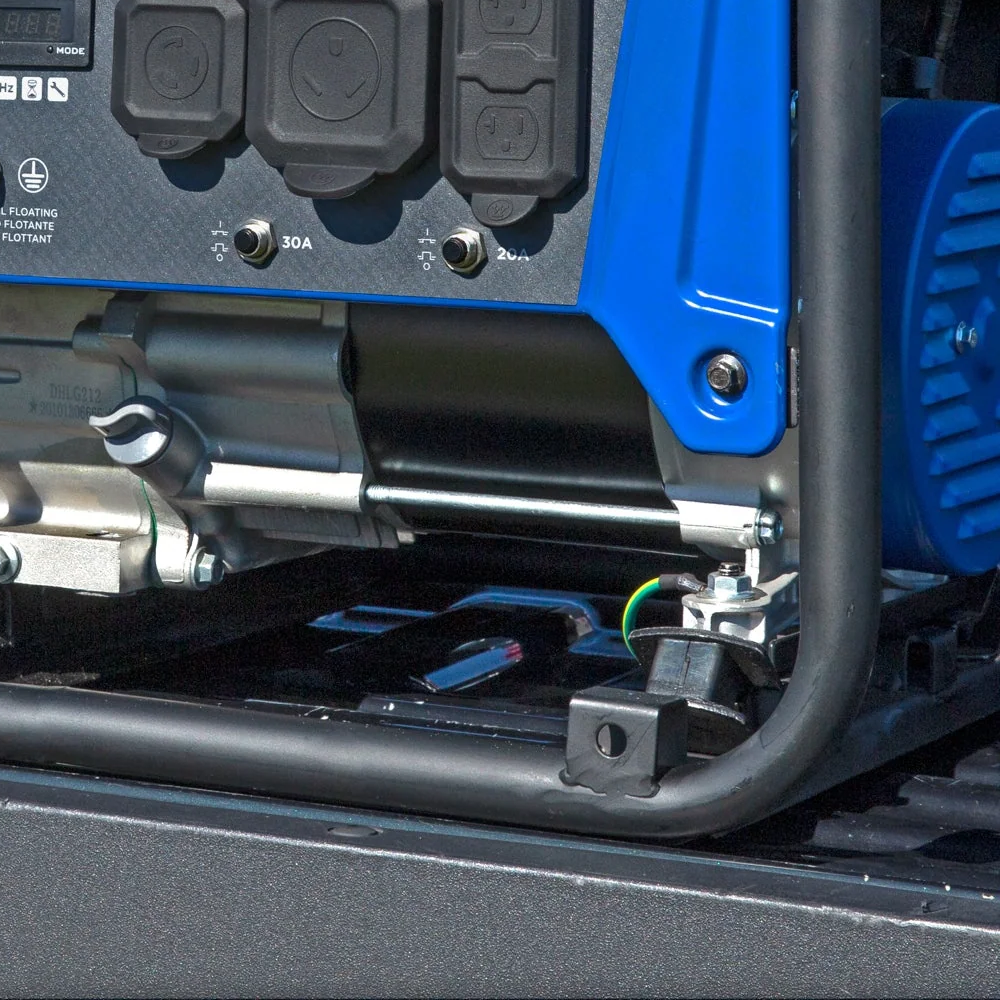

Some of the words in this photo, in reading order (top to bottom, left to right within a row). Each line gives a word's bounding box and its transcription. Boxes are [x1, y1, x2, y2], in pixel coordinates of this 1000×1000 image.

[56, 47, 85, 55] MODE
[0, 83, 14, 93] Hz
[9, 206, 58, 218] FLOATING
[4, 220, 55, 231] FLOTANTE
[2, 232, 52, 244] FLOTTANT
[282, 236, 313, 250] 30A
[497, 247, 529, 261] 20A
